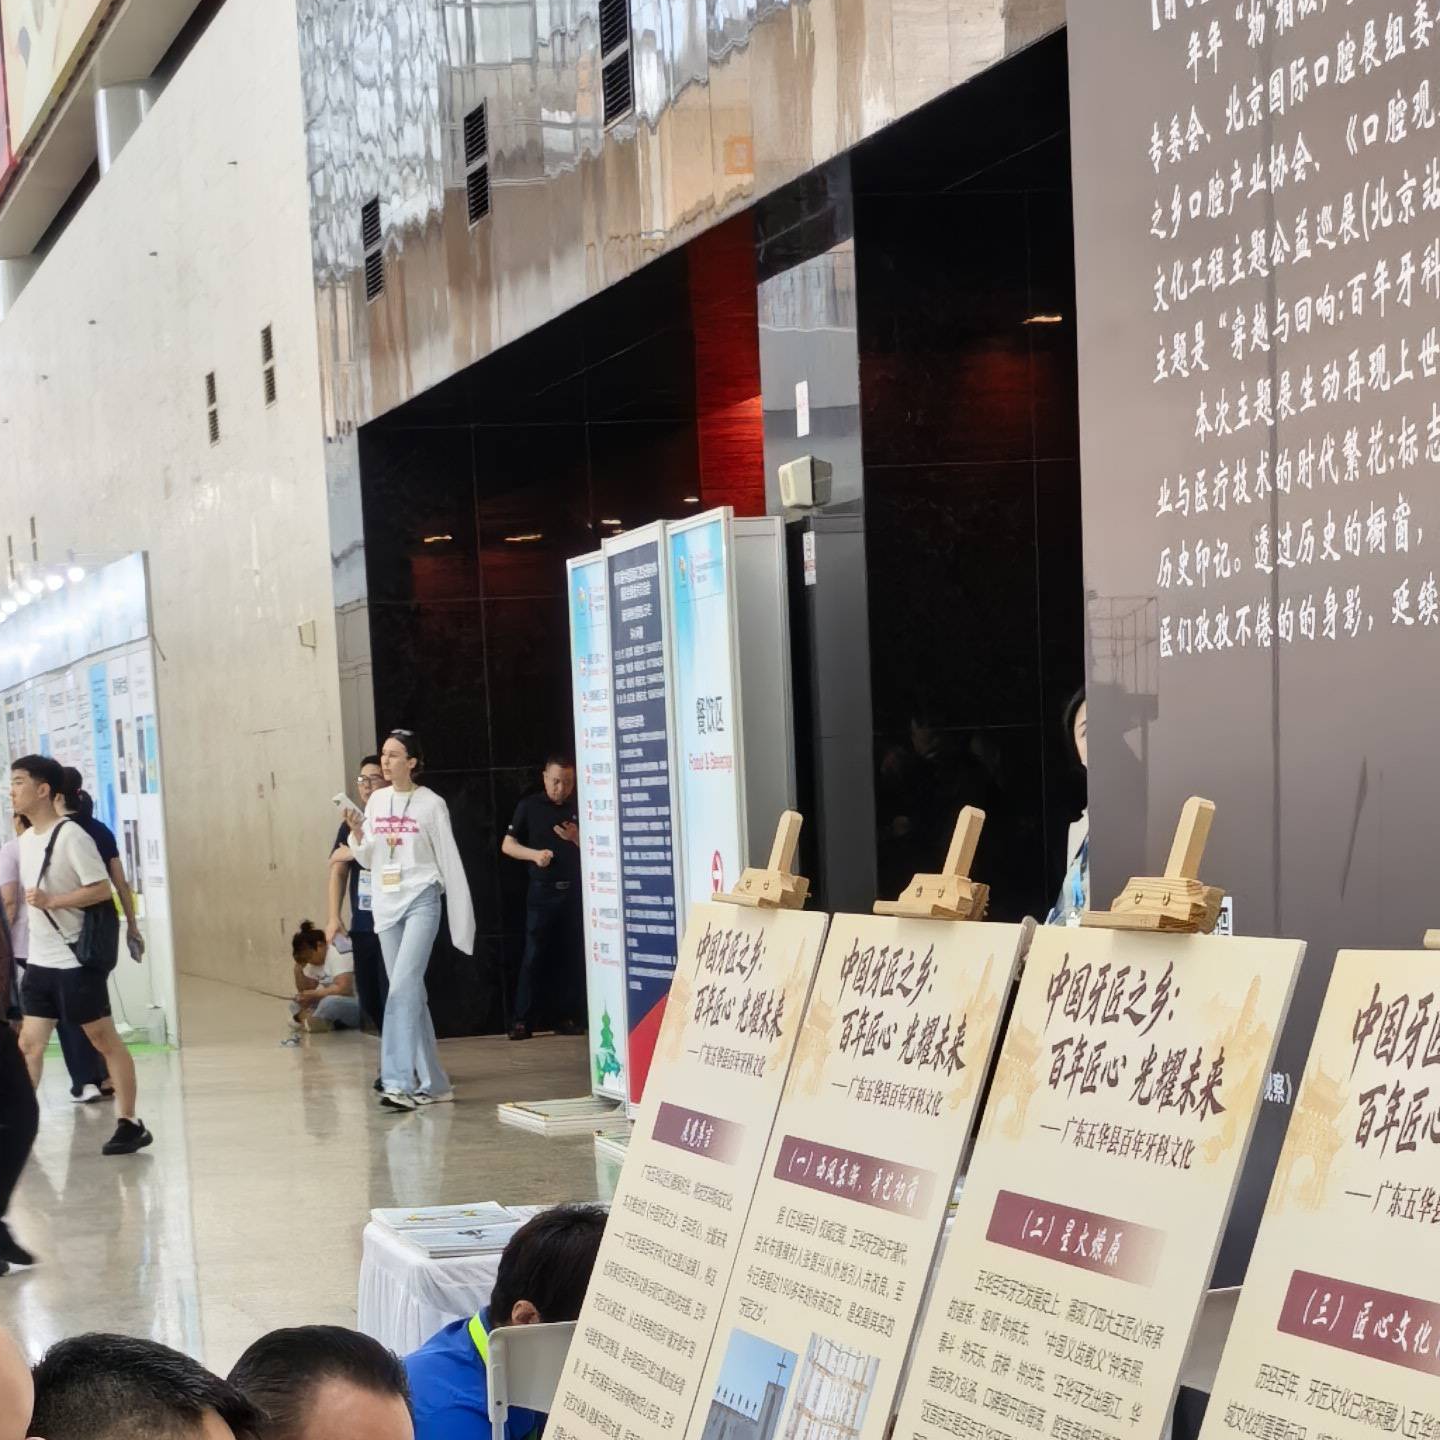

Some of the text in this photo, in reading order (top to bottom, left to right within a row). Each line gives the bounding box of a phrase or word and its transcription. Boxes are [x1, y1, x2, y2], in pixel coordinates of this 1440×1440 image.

[1047, 1033, 1225, 1121] 百年匠心 光耀未来
